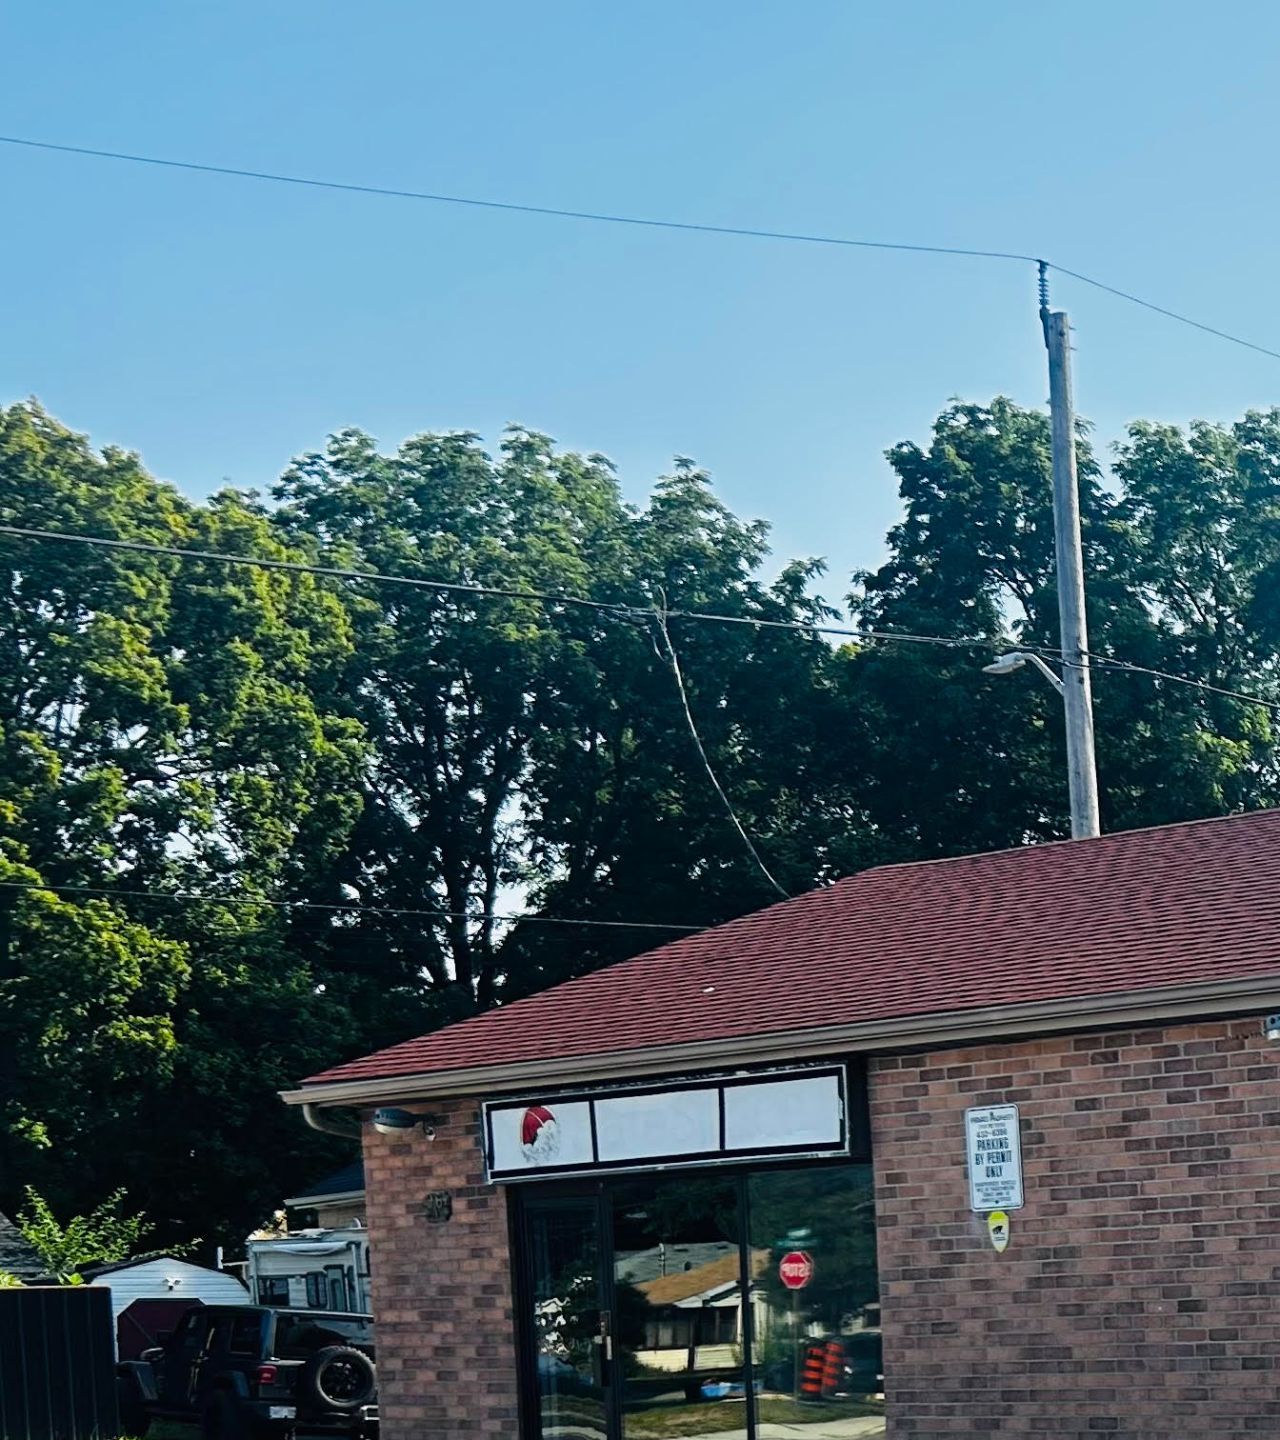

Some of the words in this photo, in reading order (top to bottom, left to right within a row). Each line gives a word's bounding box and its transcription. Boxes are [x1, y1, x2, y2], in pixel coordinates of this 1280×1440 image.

[976, 1137, 1010, 1151] PARKING
[975, 1153, 985, 1165] BY
[987, 1150, 1013, 1165] PERMIT
[986, 1166, 1004, 1178] ONLY
